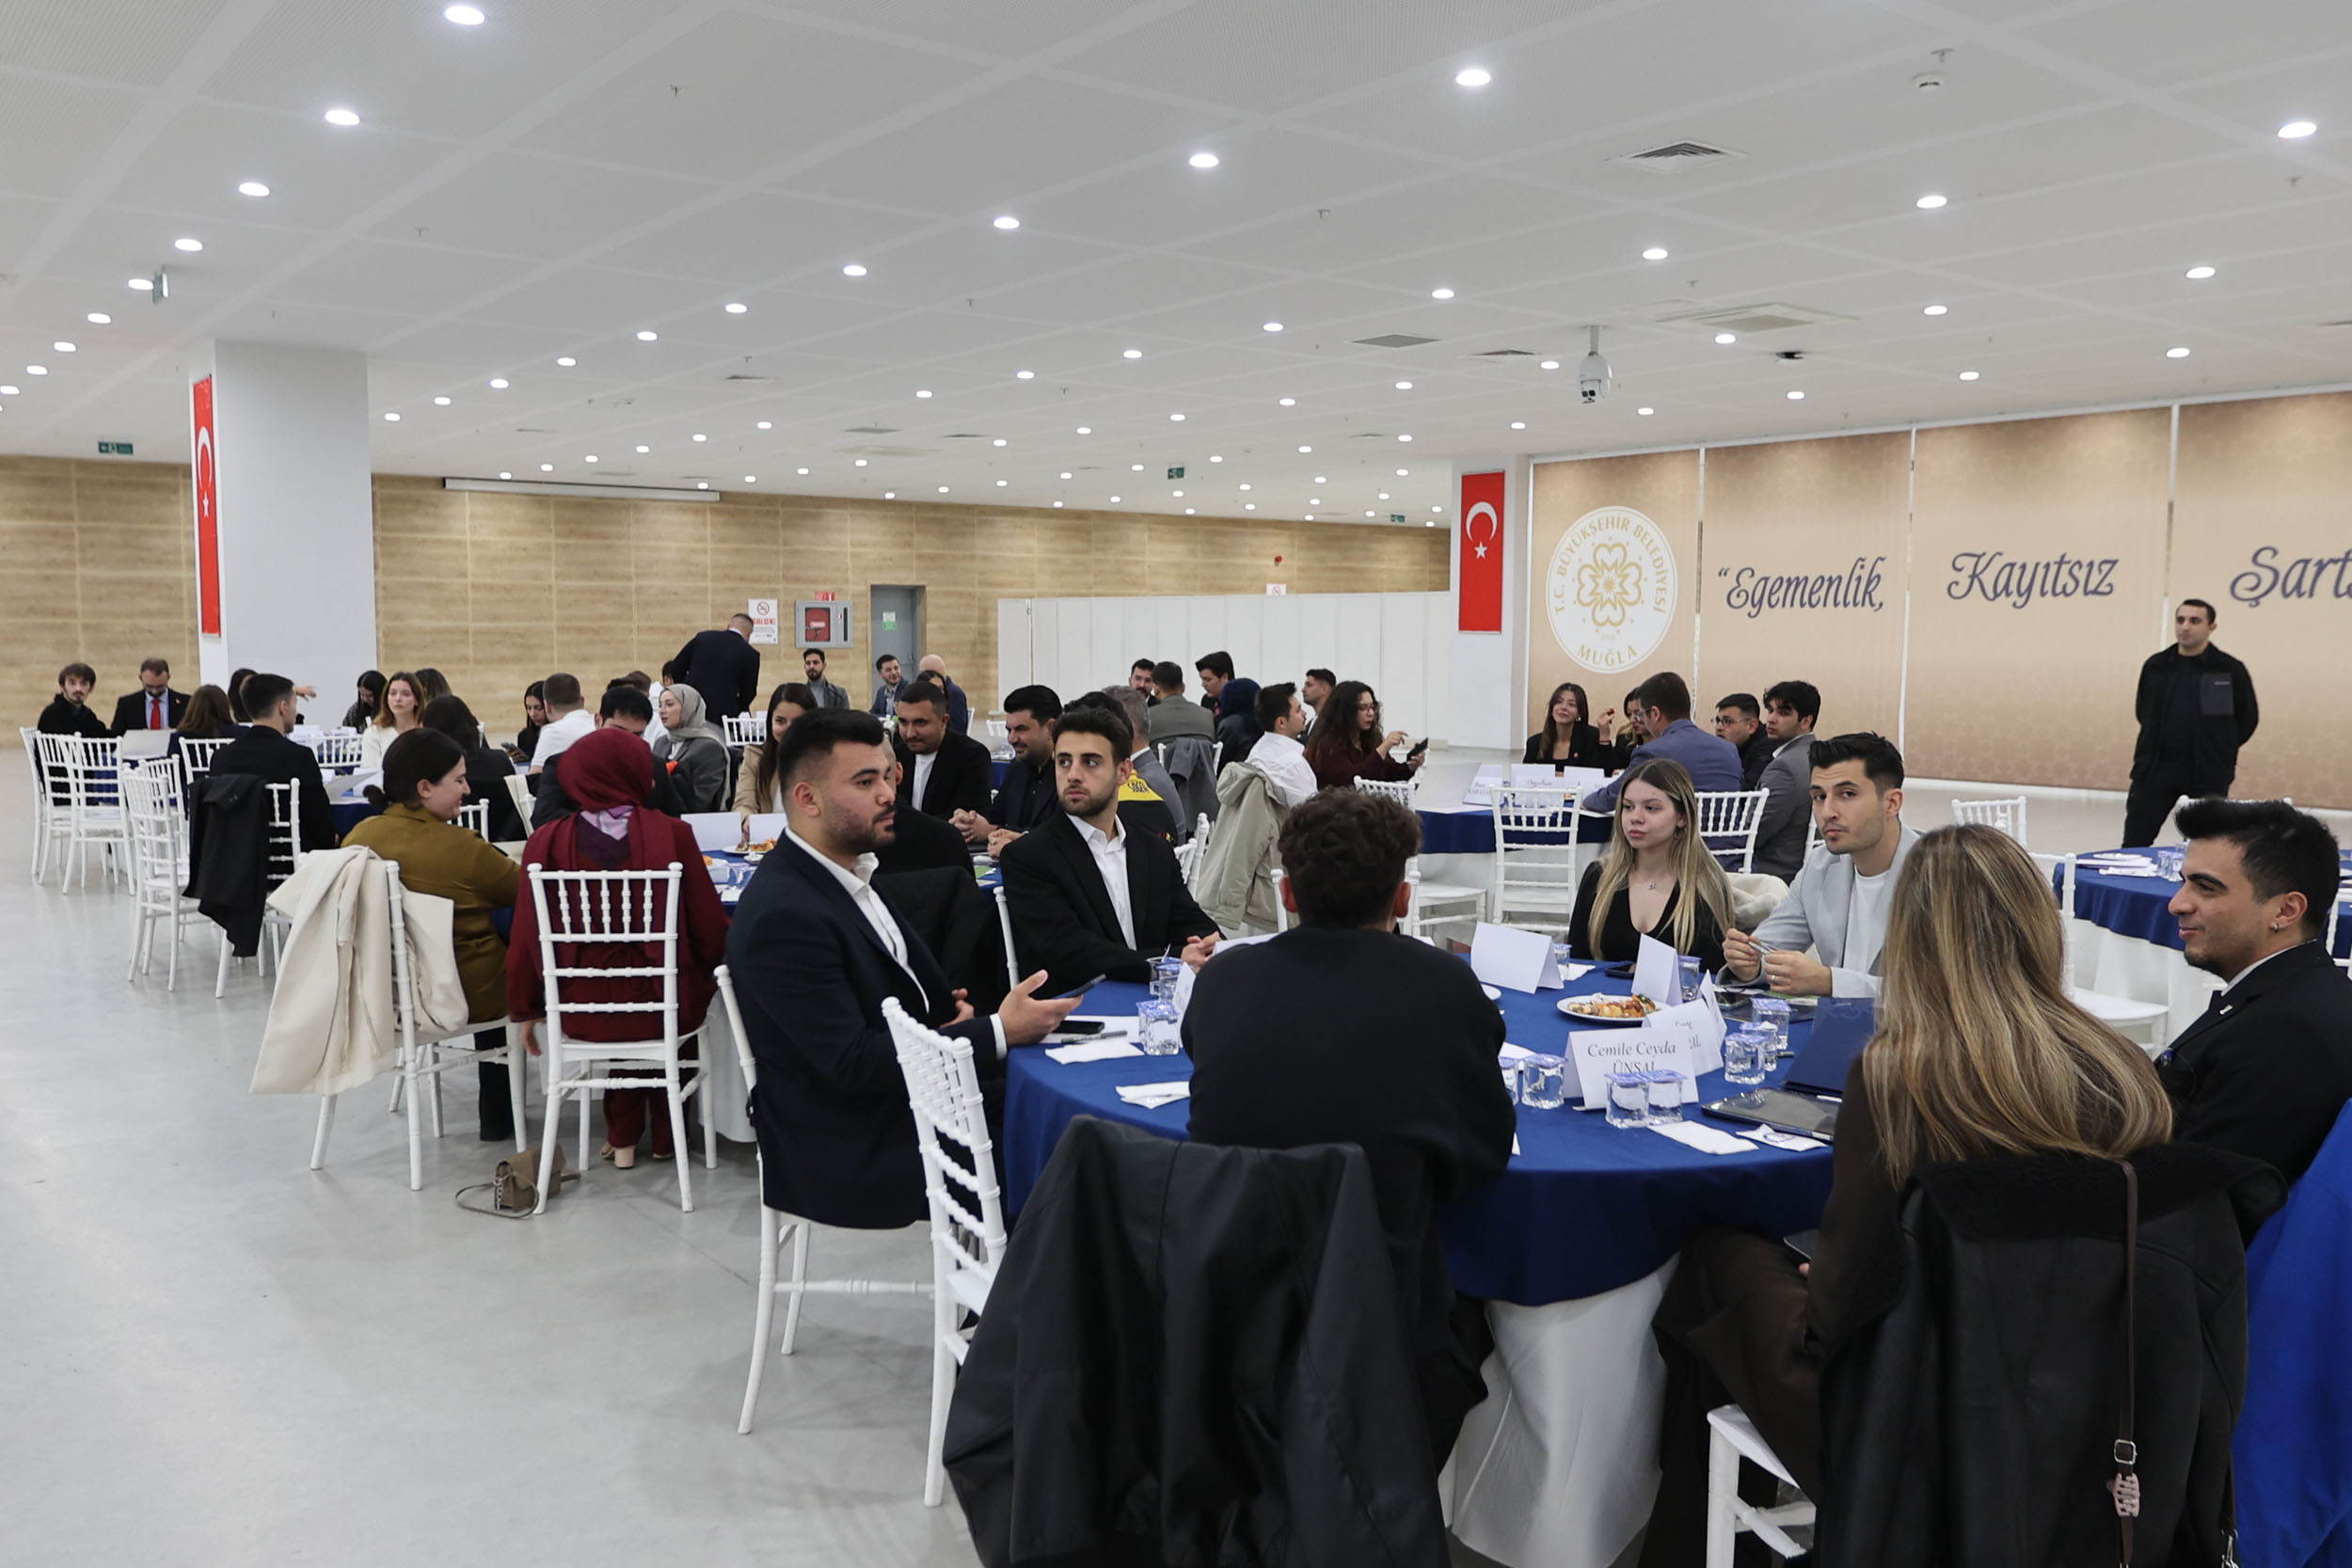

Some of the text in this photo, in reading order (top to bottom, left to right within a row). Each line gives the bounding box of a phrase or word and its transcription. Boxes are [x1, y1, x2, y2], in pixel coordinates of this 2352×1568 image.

[1557, 513, 1630, 577] BÜYÜKŞEHİR
[1947, 551, 2119, 610] Kayıtsız
[1554, 583, 1565, 614] T.C.
[1577, 643, 1638, 666] MUĞLA
[1587, 1042, 1632, 1058] Cemile
[1636, 1040, 1676, 1059] Ceyda
